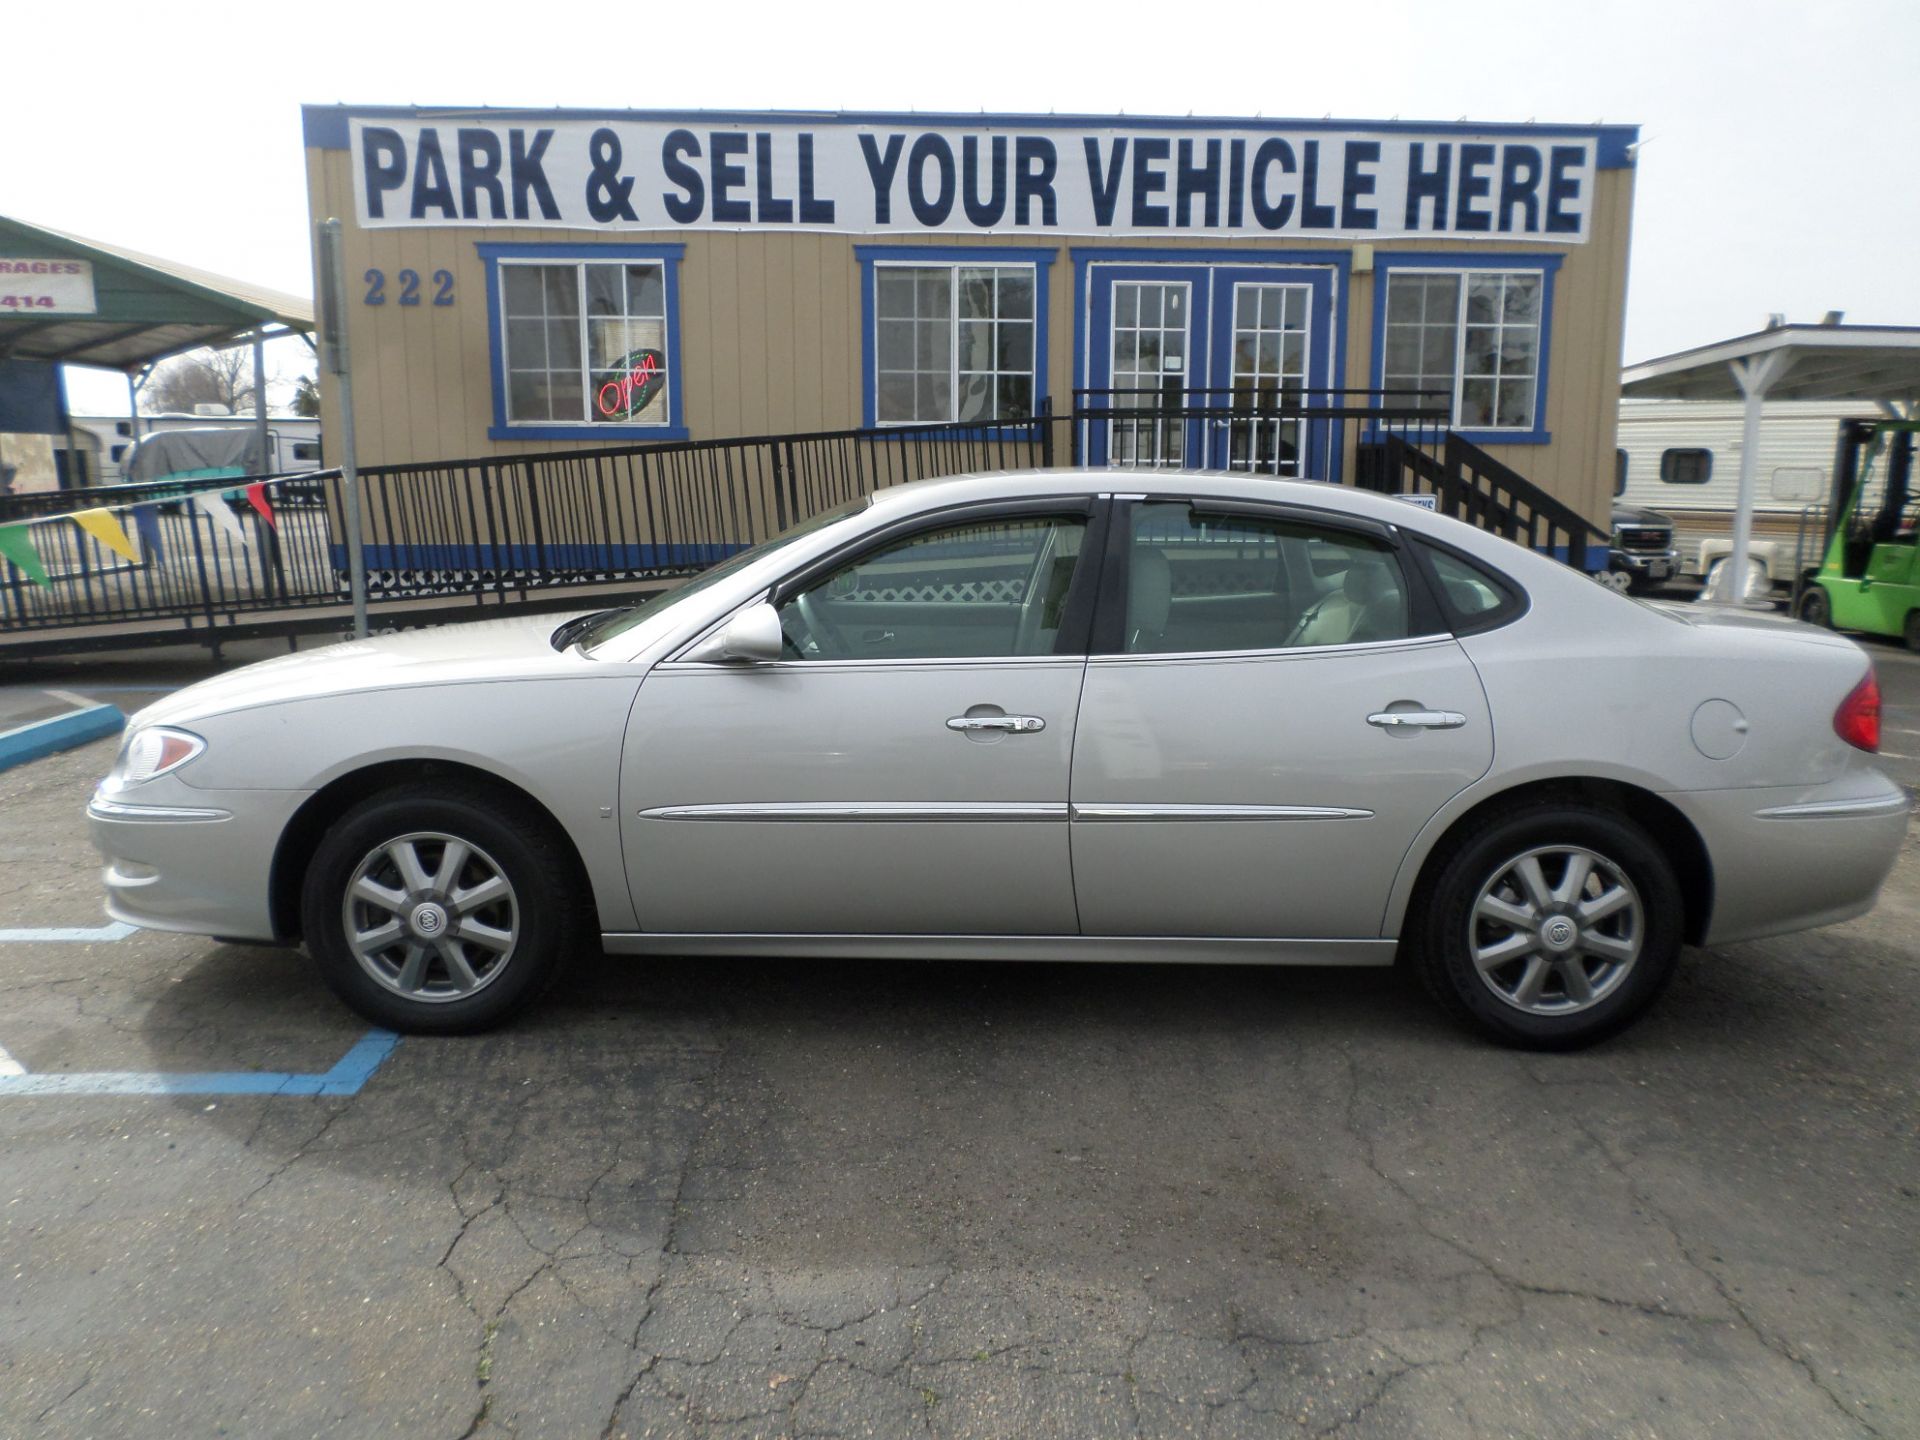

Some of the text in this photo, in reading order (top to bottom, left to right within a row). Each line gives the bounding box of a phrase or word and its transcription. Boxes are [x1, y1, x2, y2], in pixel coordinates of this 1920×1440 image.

[362, 127, 1586, 234] PARK & SELL YOUR VEHICLE HERE
[599, 353, 656, 415] Open
